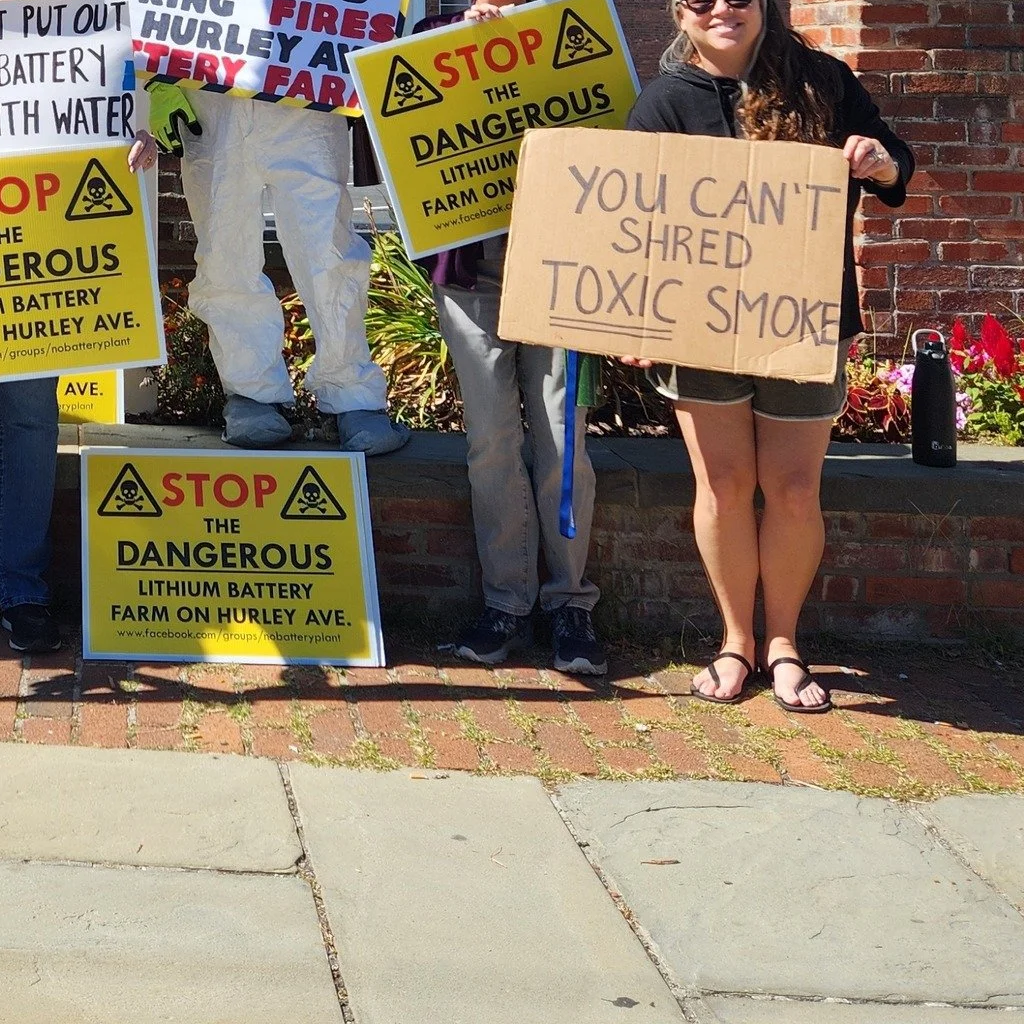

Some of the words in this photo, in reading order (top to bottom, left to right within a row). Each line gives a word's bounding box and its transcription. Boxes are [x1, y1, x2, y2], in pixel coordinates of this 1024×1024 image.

[22, 5, 67, 38] PUT
[73, 1, 126, 34] OUT
[140, 11, 302, 64] HURLEY
[133, 39, 247, 88] TERY
[263, 66, 360, 108] FAR
[433, 28, 543, 89] STOP
[483, 82, 520, 104] THE
[52, 92, 135, 138] WATER
[410, 83, 611, 162] DANGEROUS
[440, 150, 518, 186] LITHIUM
[422, 188, 478, 217] FARM
[483, 177, 516, 198] ON
[568, 165, 667, 214] YOU
[690, 176, 841, 231] CAN'T
[612, 217, 752, 269] SHRED
[12, 287, 102, 313] BATTERY
[542, 260, 683, 324] TOXIC
[706, 286, 840, 347] SMOKE
[3, 317, 85, 342] HURLEY
[93, 311, 140, 332] AVE.
[64, 382, 103, 396] AVE.
[162, 472, 278, 508] STOP
[203, 518, 240, 534] THE
[117, 540, 332, 570] DANGEROUS
[138, 580, 220, 598] LITHIUM
[228, 581, 313, 599] BATTERY
[111, 605, 170, 622] FARM
[176, 606, 210, 623] ON
[218, 607, 296, 625] HURLEY
[305, 610, 352, 626] AVE.
[116, 628, 341, 644] www.facebook.com/groups/nobatteryplant
